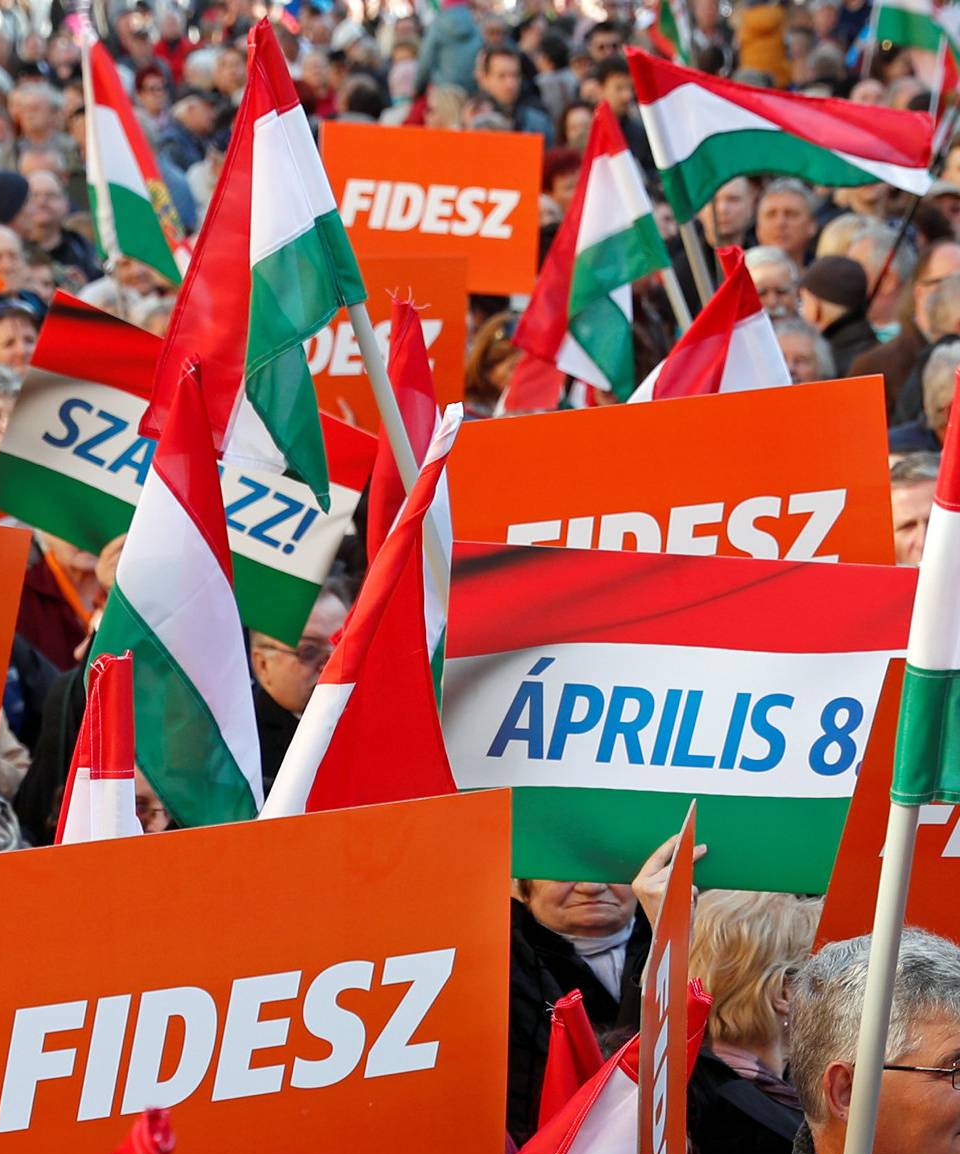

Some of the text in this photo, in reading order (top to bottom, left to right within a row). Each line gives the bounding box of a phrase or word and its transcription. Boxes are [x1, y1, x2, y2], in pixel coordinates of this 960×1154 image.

[342, 178, 522, 239] FIDESZ
[42, 398, 319, 555] SZAZZ!
[506, 488, 847, 565] ESZ
[486, 656, 796, 773] ÁPRILIS
